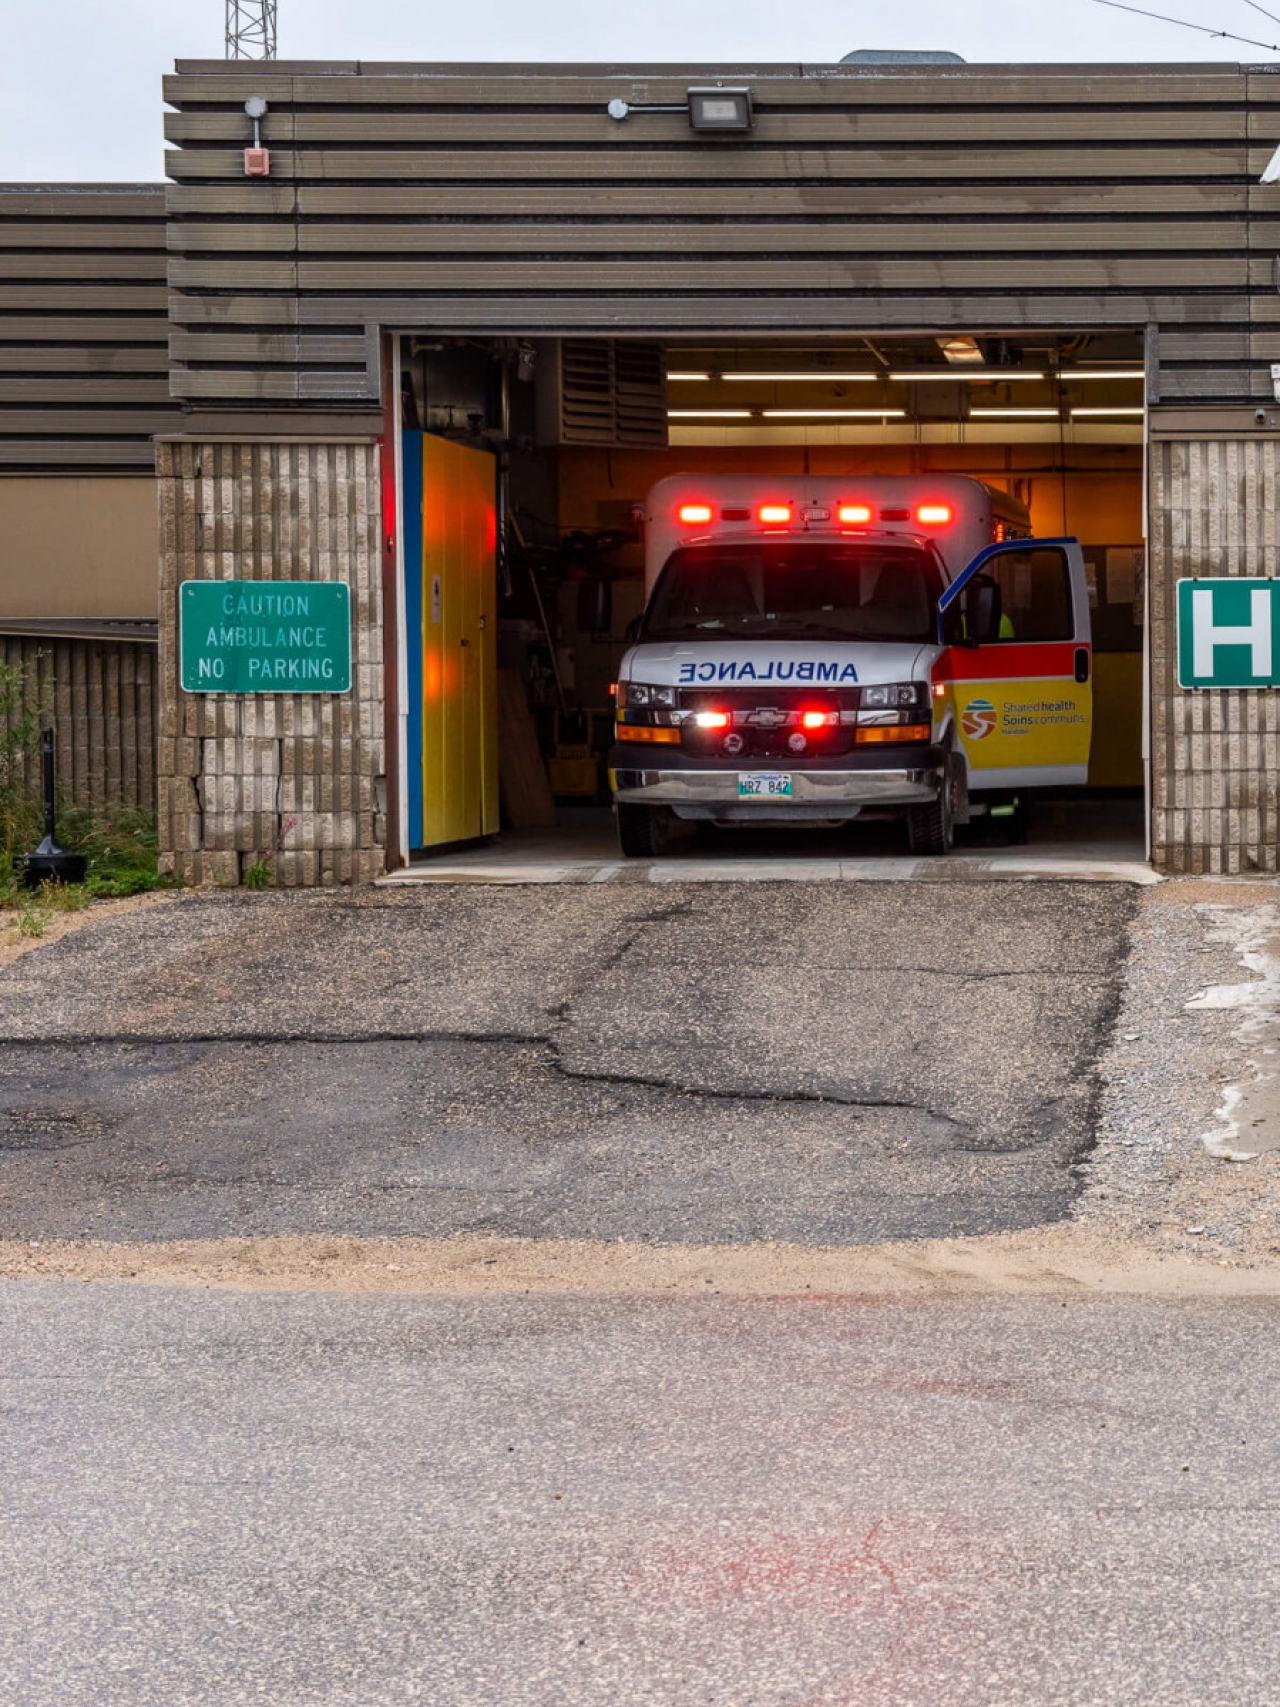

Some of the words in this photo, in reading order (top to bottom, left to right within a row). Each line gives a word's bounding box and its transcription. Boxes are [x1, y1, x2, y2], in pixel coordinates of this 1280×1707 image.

[222, 594, 310, 616] CAUTION
[206, 626, 328, 648] AMBULANCE
[1192, 589, 1272, 678] H
[198, 657, 226, 679] NO
[249, 657, 334, 679] PARKING
[1003, 702, 1040, 713] Shared
[1041, 700, 1076, 712] health
[1003, 714, 1034, 726] Soins
[1035, 713, 1085, 725] communs
[741, 780, 761, 793] HRZ
[768, 780, 790, 793] 842
